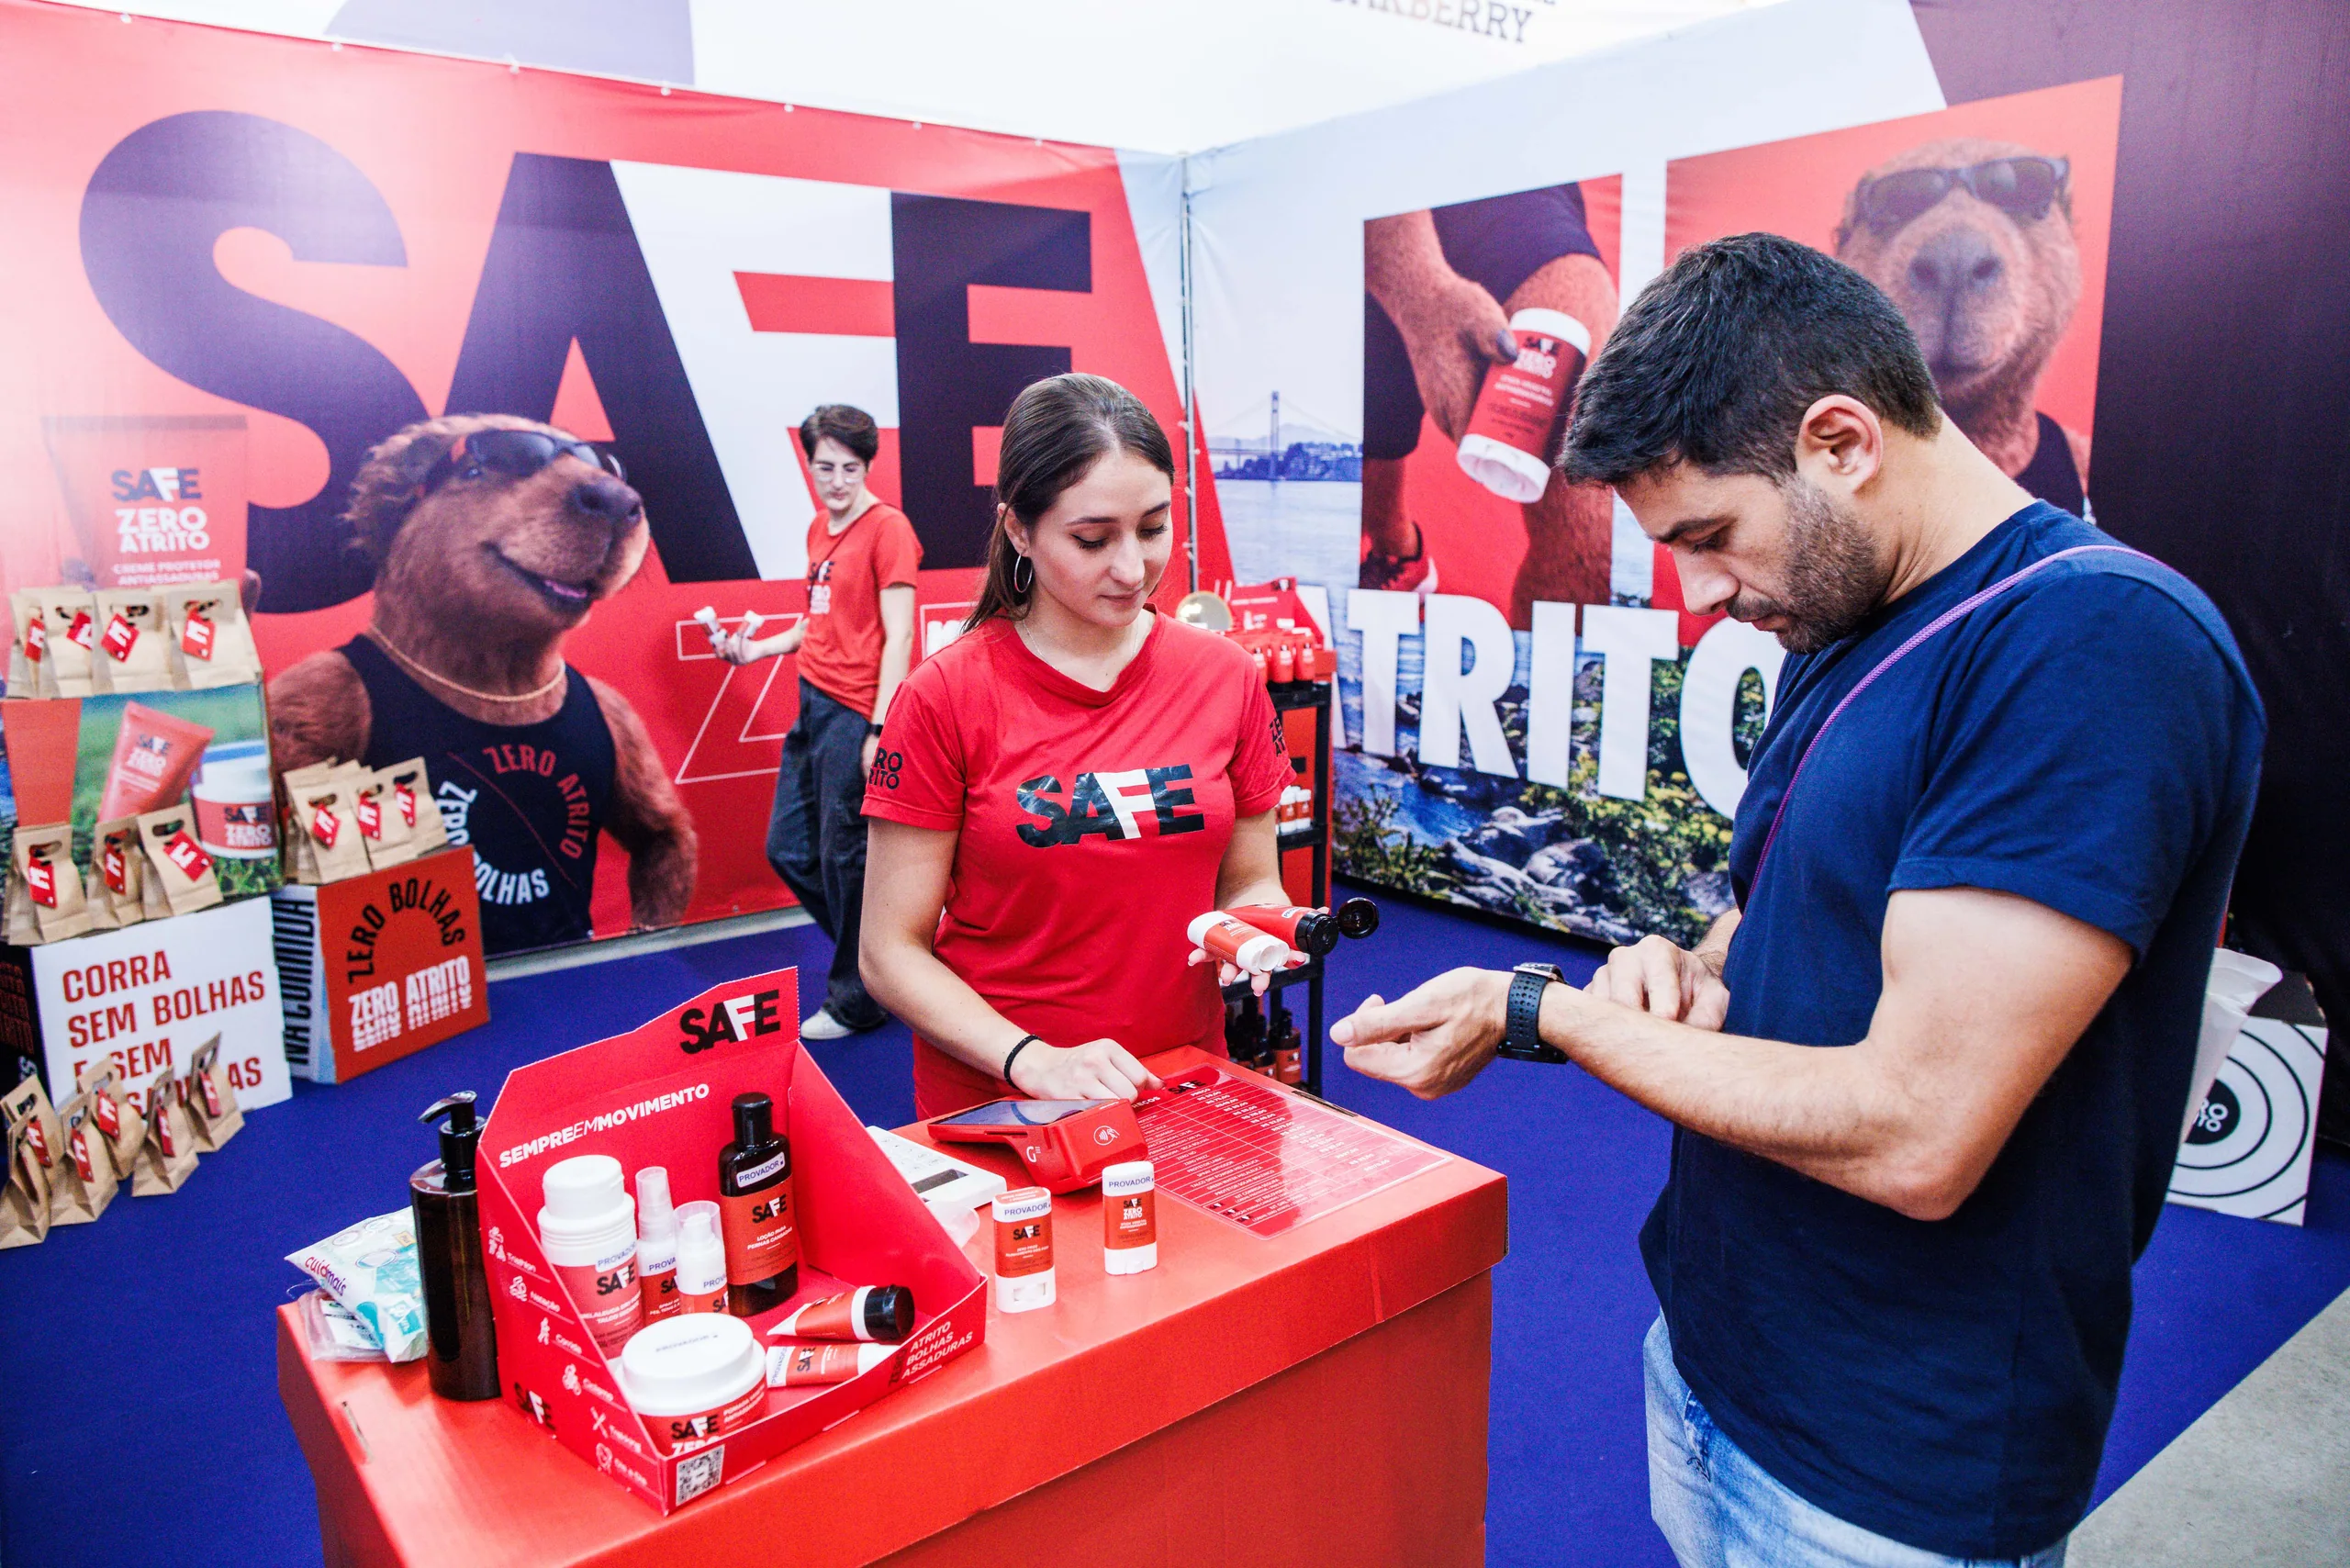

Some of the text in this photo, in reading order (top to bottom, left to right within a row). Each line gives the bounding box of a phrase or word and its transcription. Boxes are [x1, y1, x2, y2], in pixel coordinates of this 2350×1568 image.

[79, 109, 1093, 613] SAFE
[111, 467, 202, 503] SAFE
[115, 506, 207, 535] ZERO
[120, 529, 210, 554] ATRITO
[483, 744, 591, 860] ZERO ATRITO
[1016, 764, 1205, 848] SAFE
[473, 850, 550, 905] OLHAS
[347, 878, 466, 984] ZERO BOLHAS
[62, 949, 173, 1003] CORRA
[348, 956, 472, 1029] ZERO ATRITO
[67, 1002, 138, 1050] SEM
[151, 970, 265, 1027] BOLHAS
[679, 989, 780, 1055] SAFE
[110, 1038, 174, 1081] SEM
[1168, 1081, 1206, 1095] SAFE
[739, 1160, 779, 1183] PROVADOR
[1109, 1175, 1151, 1189] PROVADOR
[752, 1193, 788, 1225] SAFE
[1004, 1202, 1048, 1216] PROVADOR
[1123, 1206, 1143, 1215] ZERO
[1124, 1197, 1142, 1209] SAFE
[1013, 1225, 1041, 1241] SAFE
[596, 1261, 636, 1296] SAFE
[648, 1256, 677, 1272] PROVA
[906, 1331, 954, 1367] BOLHAS
[910, 1321, 951, 1353] ATRITO
[901, 1331, 973, 1380] ASSADURAS
[671, 1414, 720, 1440] SAFE
